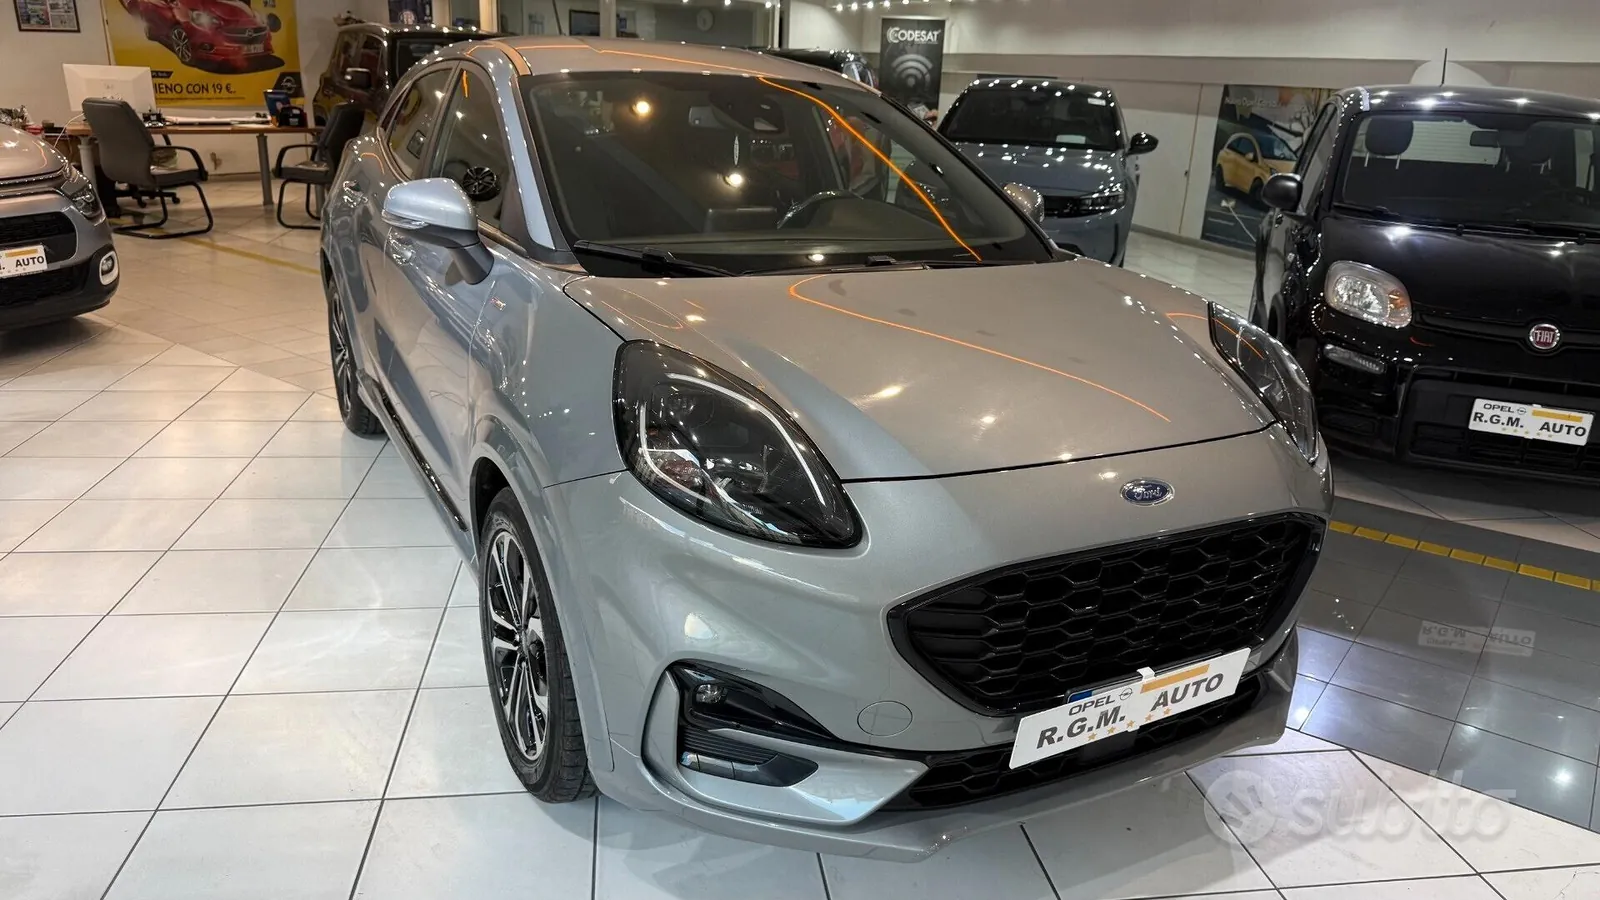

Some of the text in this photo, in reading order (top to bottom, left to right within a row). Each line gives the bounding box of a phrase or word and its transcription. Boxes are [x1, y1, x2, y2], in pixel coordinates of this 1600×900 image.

[886, 26, 941, 43] CODESAT
[186, 83, 209, 94] CON
[212, 83, 223, 94] 19
[15, 256, 45, 268] AUTO
[1534, 330, 1555, 343] FIAT
[1483, 403, 1515, 414] OPEL
[1473, 411, 1587, 437] R.G.M. AUTO
[1133, 484, 1163, 500] Ford
[1036, 673, 1225, 749] R.G.M. AUTO
[1068, 694, 1116, 716] OPEL
